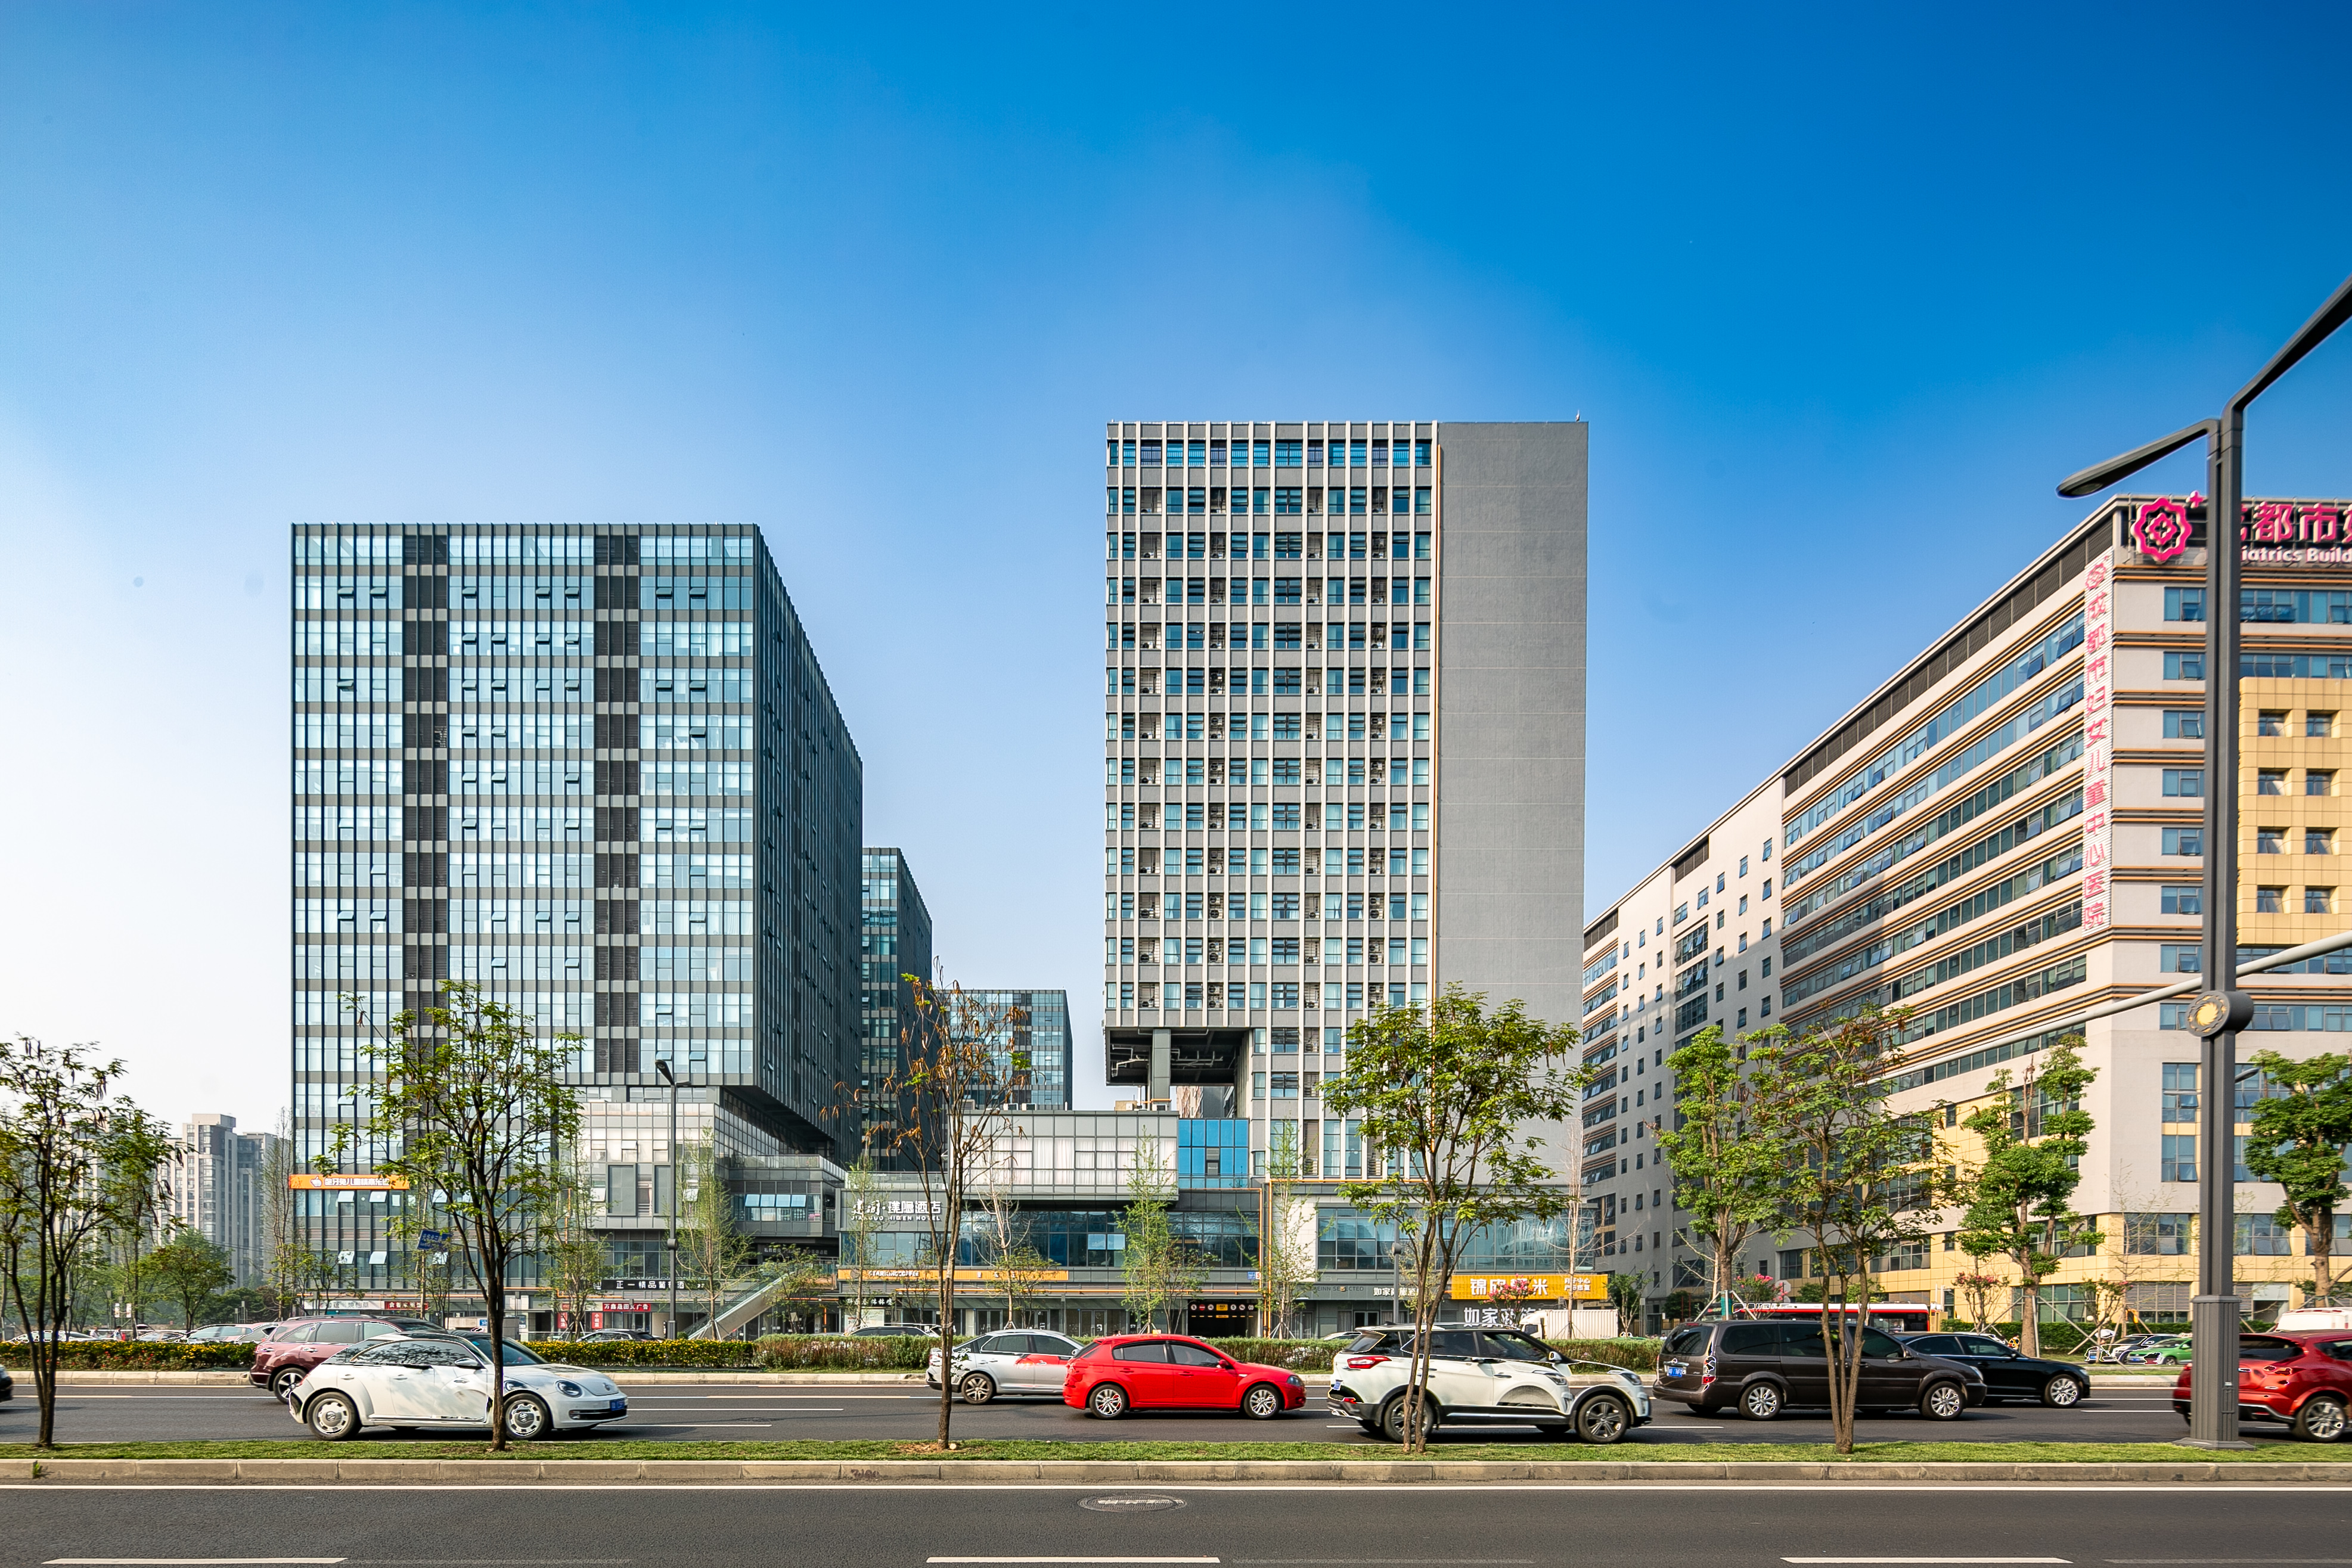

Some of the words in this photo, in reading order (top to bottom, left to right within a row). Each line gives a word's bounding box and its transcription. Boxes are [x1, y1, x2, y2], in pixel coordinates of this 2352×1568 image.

[2241, 502, 2352, 544] 都市
[2084, 591, 2108, 931] 成都市妇女儿童中心医院
[1470, 1278, 1549, 1296] 锦欣米
